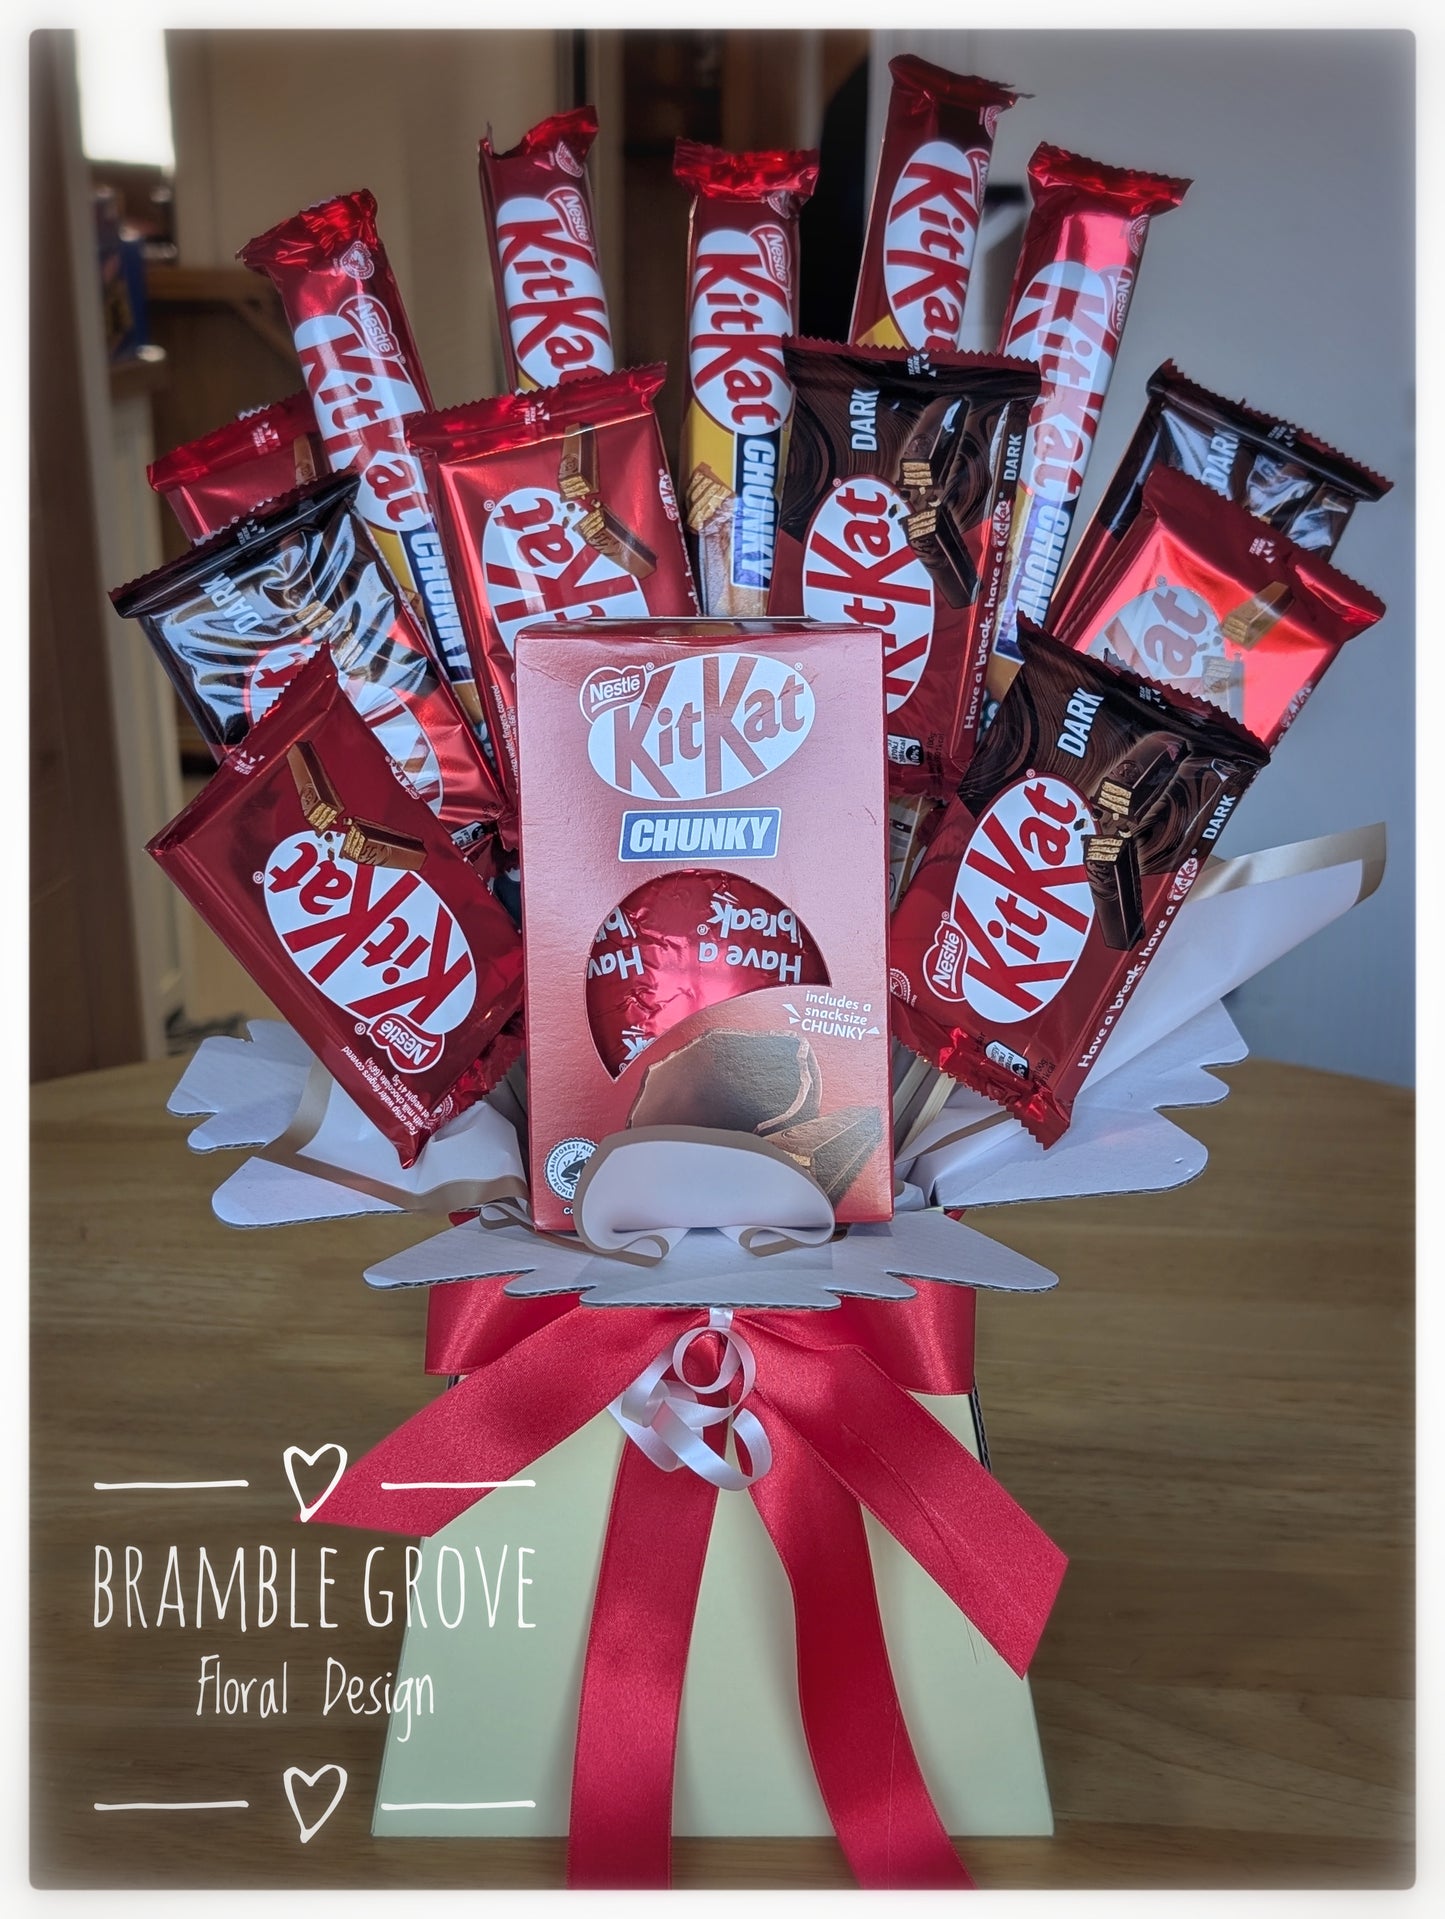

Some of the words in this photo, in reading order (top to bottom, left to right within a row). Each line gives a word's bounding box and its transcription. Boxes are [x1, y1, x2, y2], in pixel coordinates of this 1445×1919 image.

[691, 253, 791, 427] KitKat
[300, 333, 428, 524] KitKat
[850, 388, 879, 451] DARK
[1003, 434, 1022, 480] DARK
[1202, 427, 1240, 490] DARK
[742, 439, 776, 581] CHUNKY
[486, 497, 638, 621] Kat
[1008, 505, 1070, 640] CHUN
[203, 573, 264, 635] DARK
[806, 488, 931, 704] tKat
[963, 686, 981, 729] Have
[984, 568, 1000, 607] have
[613, 656, 806, 799] KitKat
[1057, 687, 1104, 758] DARK
[629, 816, 771, 853] CHUNKY
[1203, 794, 1236, 841] DARK
[707, 901, 798, 943] break
[954, 782, 1090, 1013] KitKat
[268, 842, 472, 1026] KitKat
[588, 946, 644, 980] Hav
[699, 942, 718, 962] a
[726, 945, 801, 984] Have
[804, 1007, 868, 1026] snacksize
[805, 990, 859, 1010] includes
[863, 1003, 872, 1013] a
[1078, 1027, 1107, 1069] Have
[1139, 919, 1166, 964] have
[801, 1019, 867, 1041] CHUNKY
